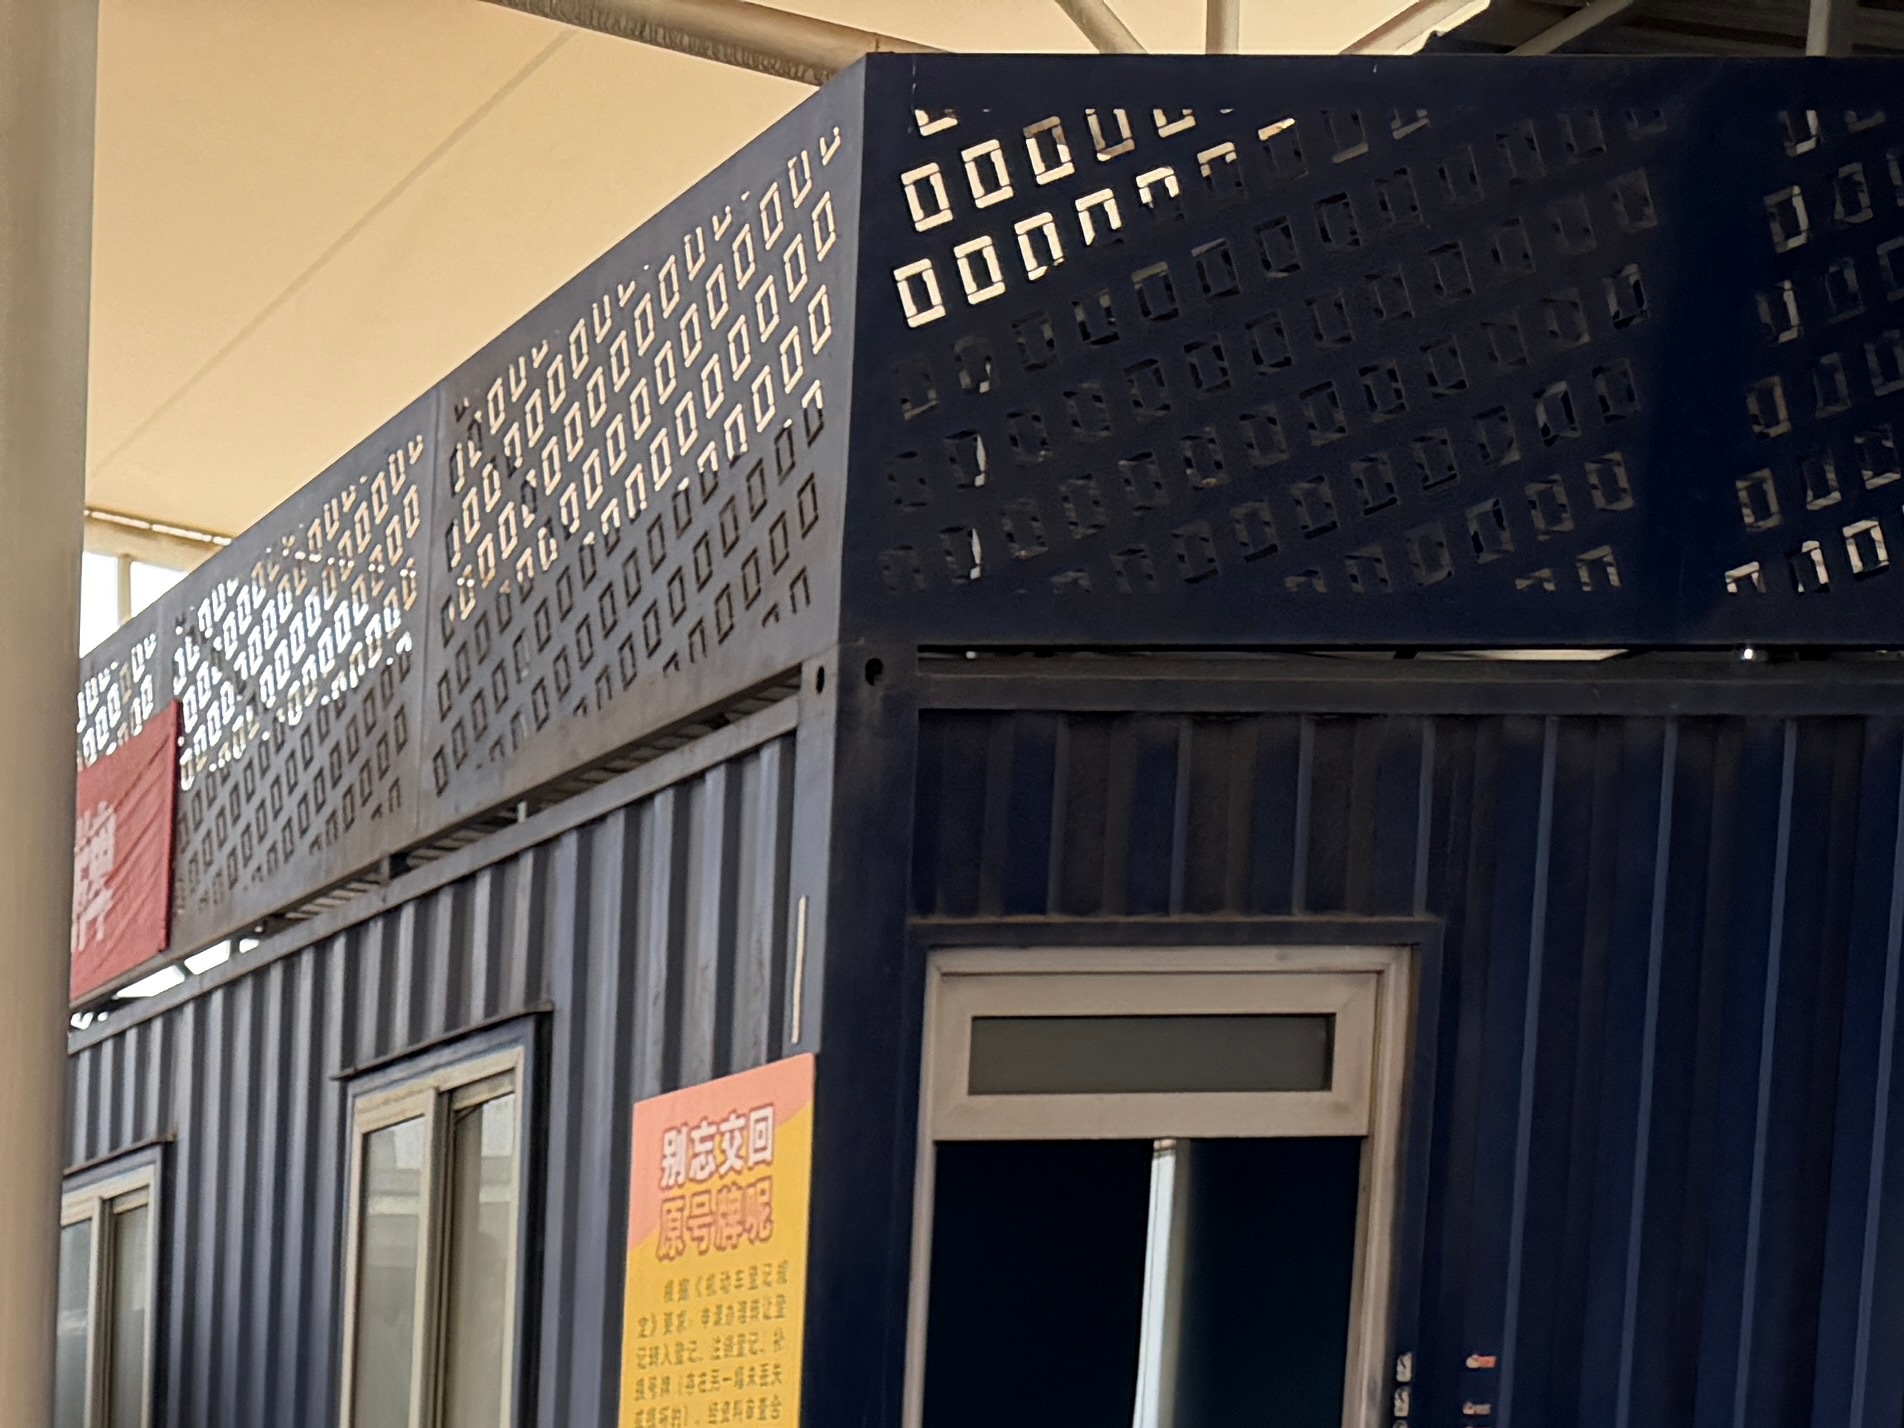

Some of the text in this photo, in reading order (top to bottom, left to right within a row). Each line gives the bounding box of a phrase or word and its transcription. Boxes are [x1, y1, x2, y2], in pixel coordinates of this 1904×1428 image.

[660, 1103, 774, 1190] 别忘交回
[656, 1176, 774, 1261] 原号牌呢
